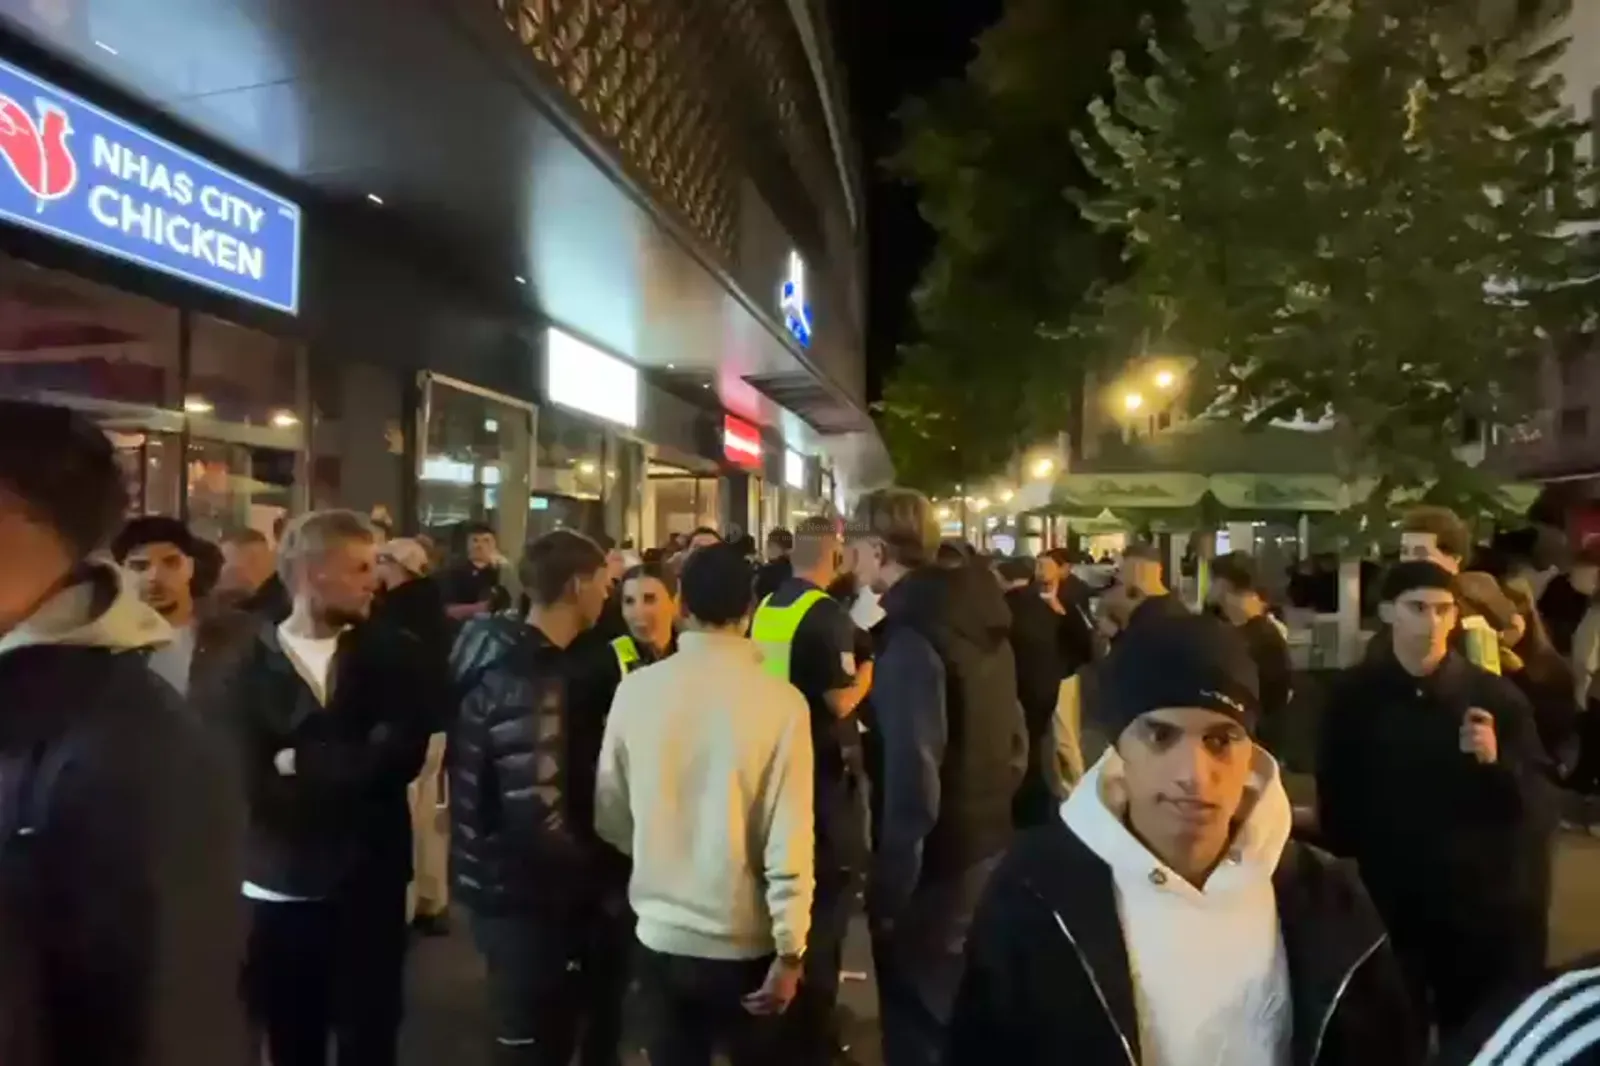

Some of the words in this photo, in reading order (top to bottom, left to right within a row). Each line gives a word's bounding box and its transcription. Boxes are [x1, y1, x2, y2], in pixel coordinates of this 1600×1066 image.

[88, 184, 263, 280] CHICKEN
[93, 134, 194, 206] NHAS
[201, 185, 265, 234] CITY
